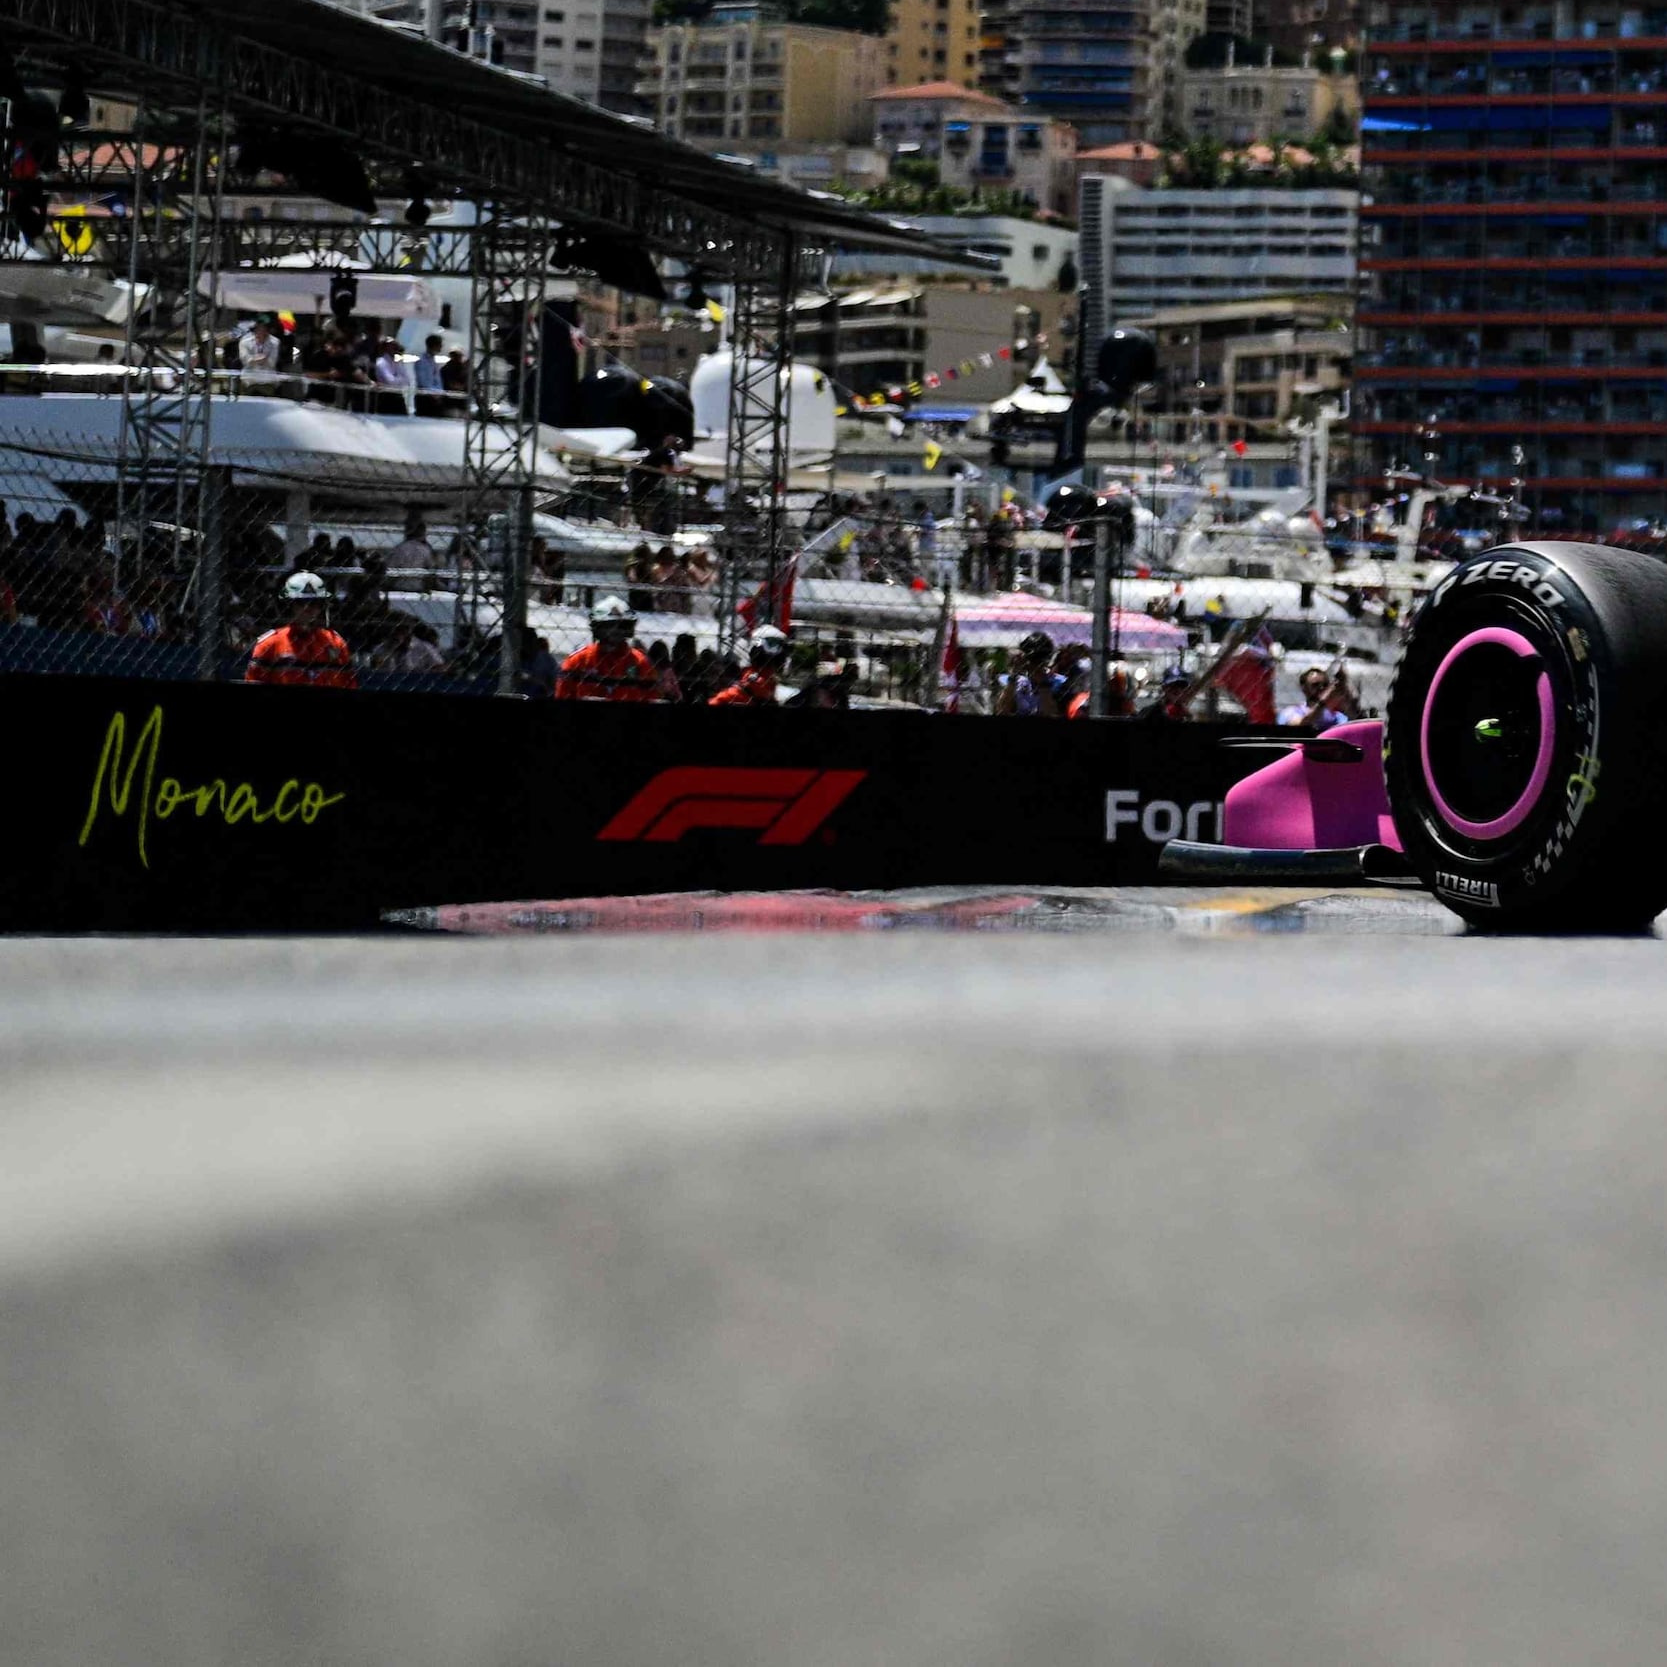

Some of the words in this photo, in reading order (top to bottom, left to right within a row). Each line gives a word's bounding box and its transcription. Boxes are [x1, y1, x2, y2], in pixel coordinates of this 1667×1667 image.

[1461, 561, 1566, 608] ZERO
[79, 705, 347, 868] Monaco
[596, 766, 867, 845] F1
[1105, 789, 1224, 843] For
[1435, 871, 1500, 907] PIRELLI
